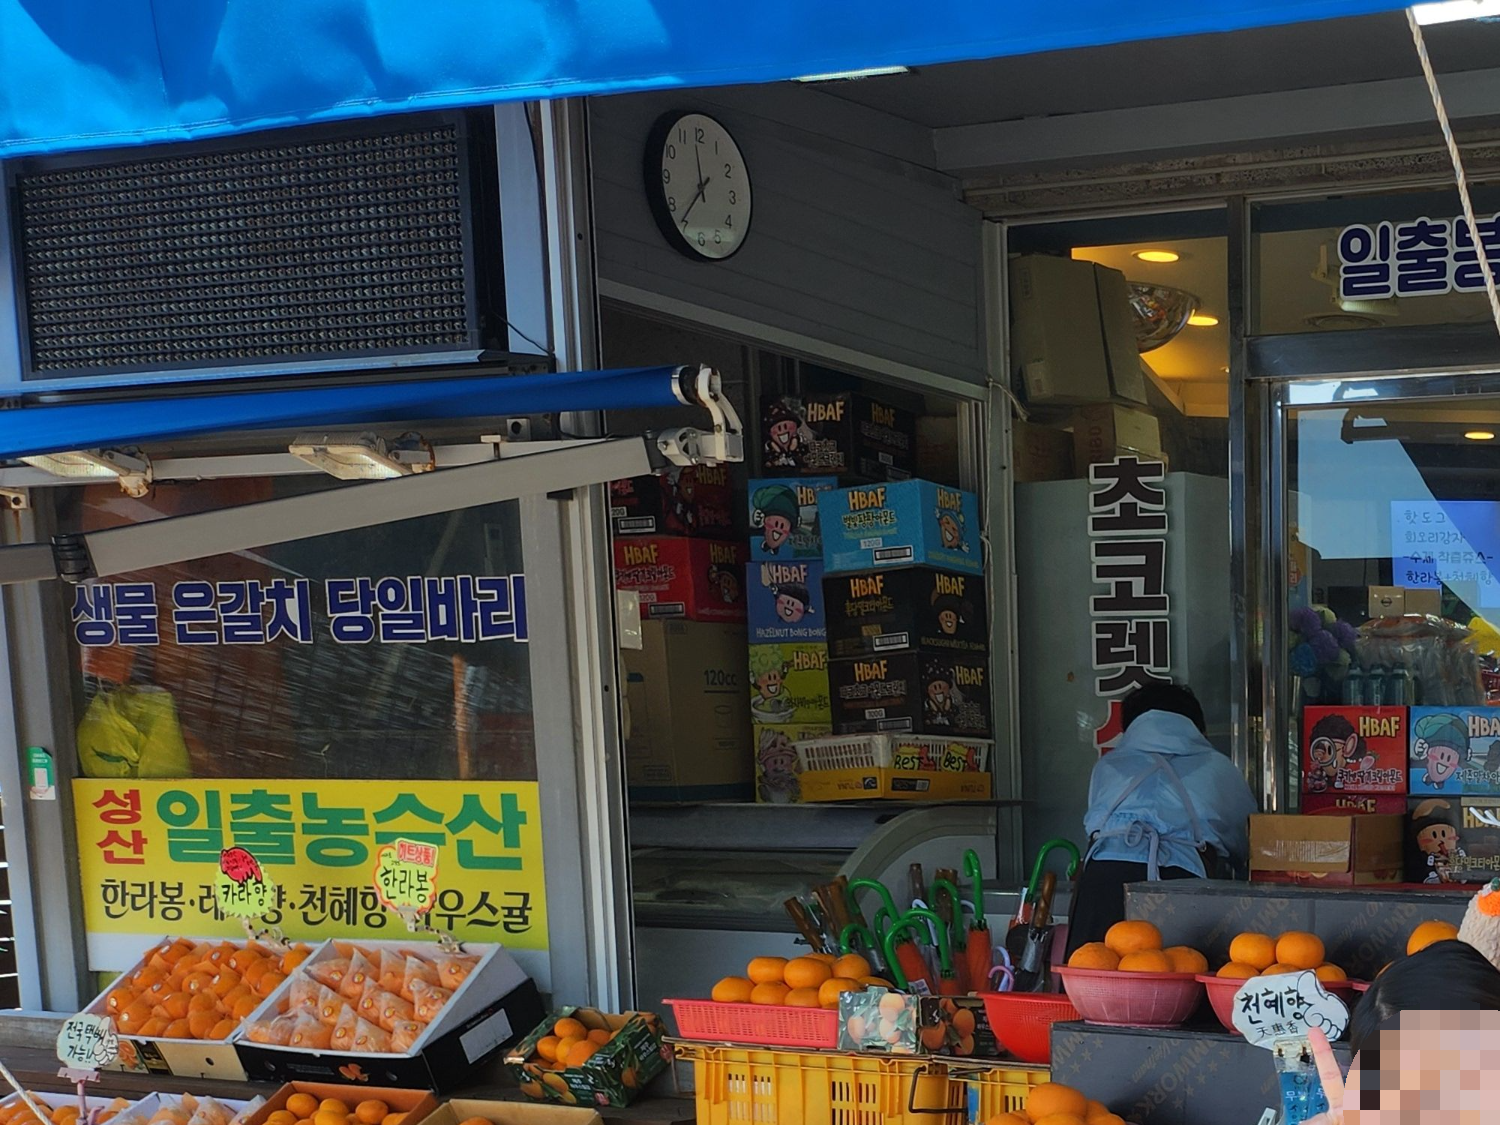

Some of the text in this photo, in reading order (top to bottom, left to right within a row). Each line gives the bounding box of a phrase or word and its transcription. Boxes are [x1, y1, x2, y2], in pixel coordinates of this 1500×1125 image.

[678, 128, 687, 144] 11
[695, 128, 705, 144] 12
[665, 144, 676, 160] 10
[715, 141, 718, 155] 1
[662, 169, 671, 184] 9
[724, 163, 732, 179] 2
[668, 197, 677, 212] 8
[728, 190, 736, 205] 3
[682, 220, 689, 234] 7
[724, 214, 732, 229] 4
[697, 232, 706, 246] 6
[714, 230, 722, 244] 5
[807, 402, 845, 421] HBAF
[872, 403, 895, 427] HBAF
[848, 488, 887, 511] HBAF
[937, 488, 962, 512] HBAF
[624, 544, 658, 565] HBAF
[709, 543, 737, 564] HBAF
[773, 564, 807, 584] HBAF
[850, 575, 884, 598] HBAF
[935, 574, 965, 597] HBAF
[72, 574, 530, 648] 생물 은갈치 당일바리
[756, 629, 788, 637] HAZELNUT
[793, 651, 827, 671] HBAF
[854, 660, 888, 682] HBAF
[704, 669, 737, 686] 120cc
[956, 666, 984, 686] HBAF
[1358, 716, 1400, 737] HBAF
[157, 789, 528, 871] 일출농수산
[220, 881, 268, 908] 카라향
[380, 866, 430, 904] 한라봉
[1241, 985, 1306, 1025] 천혜향
